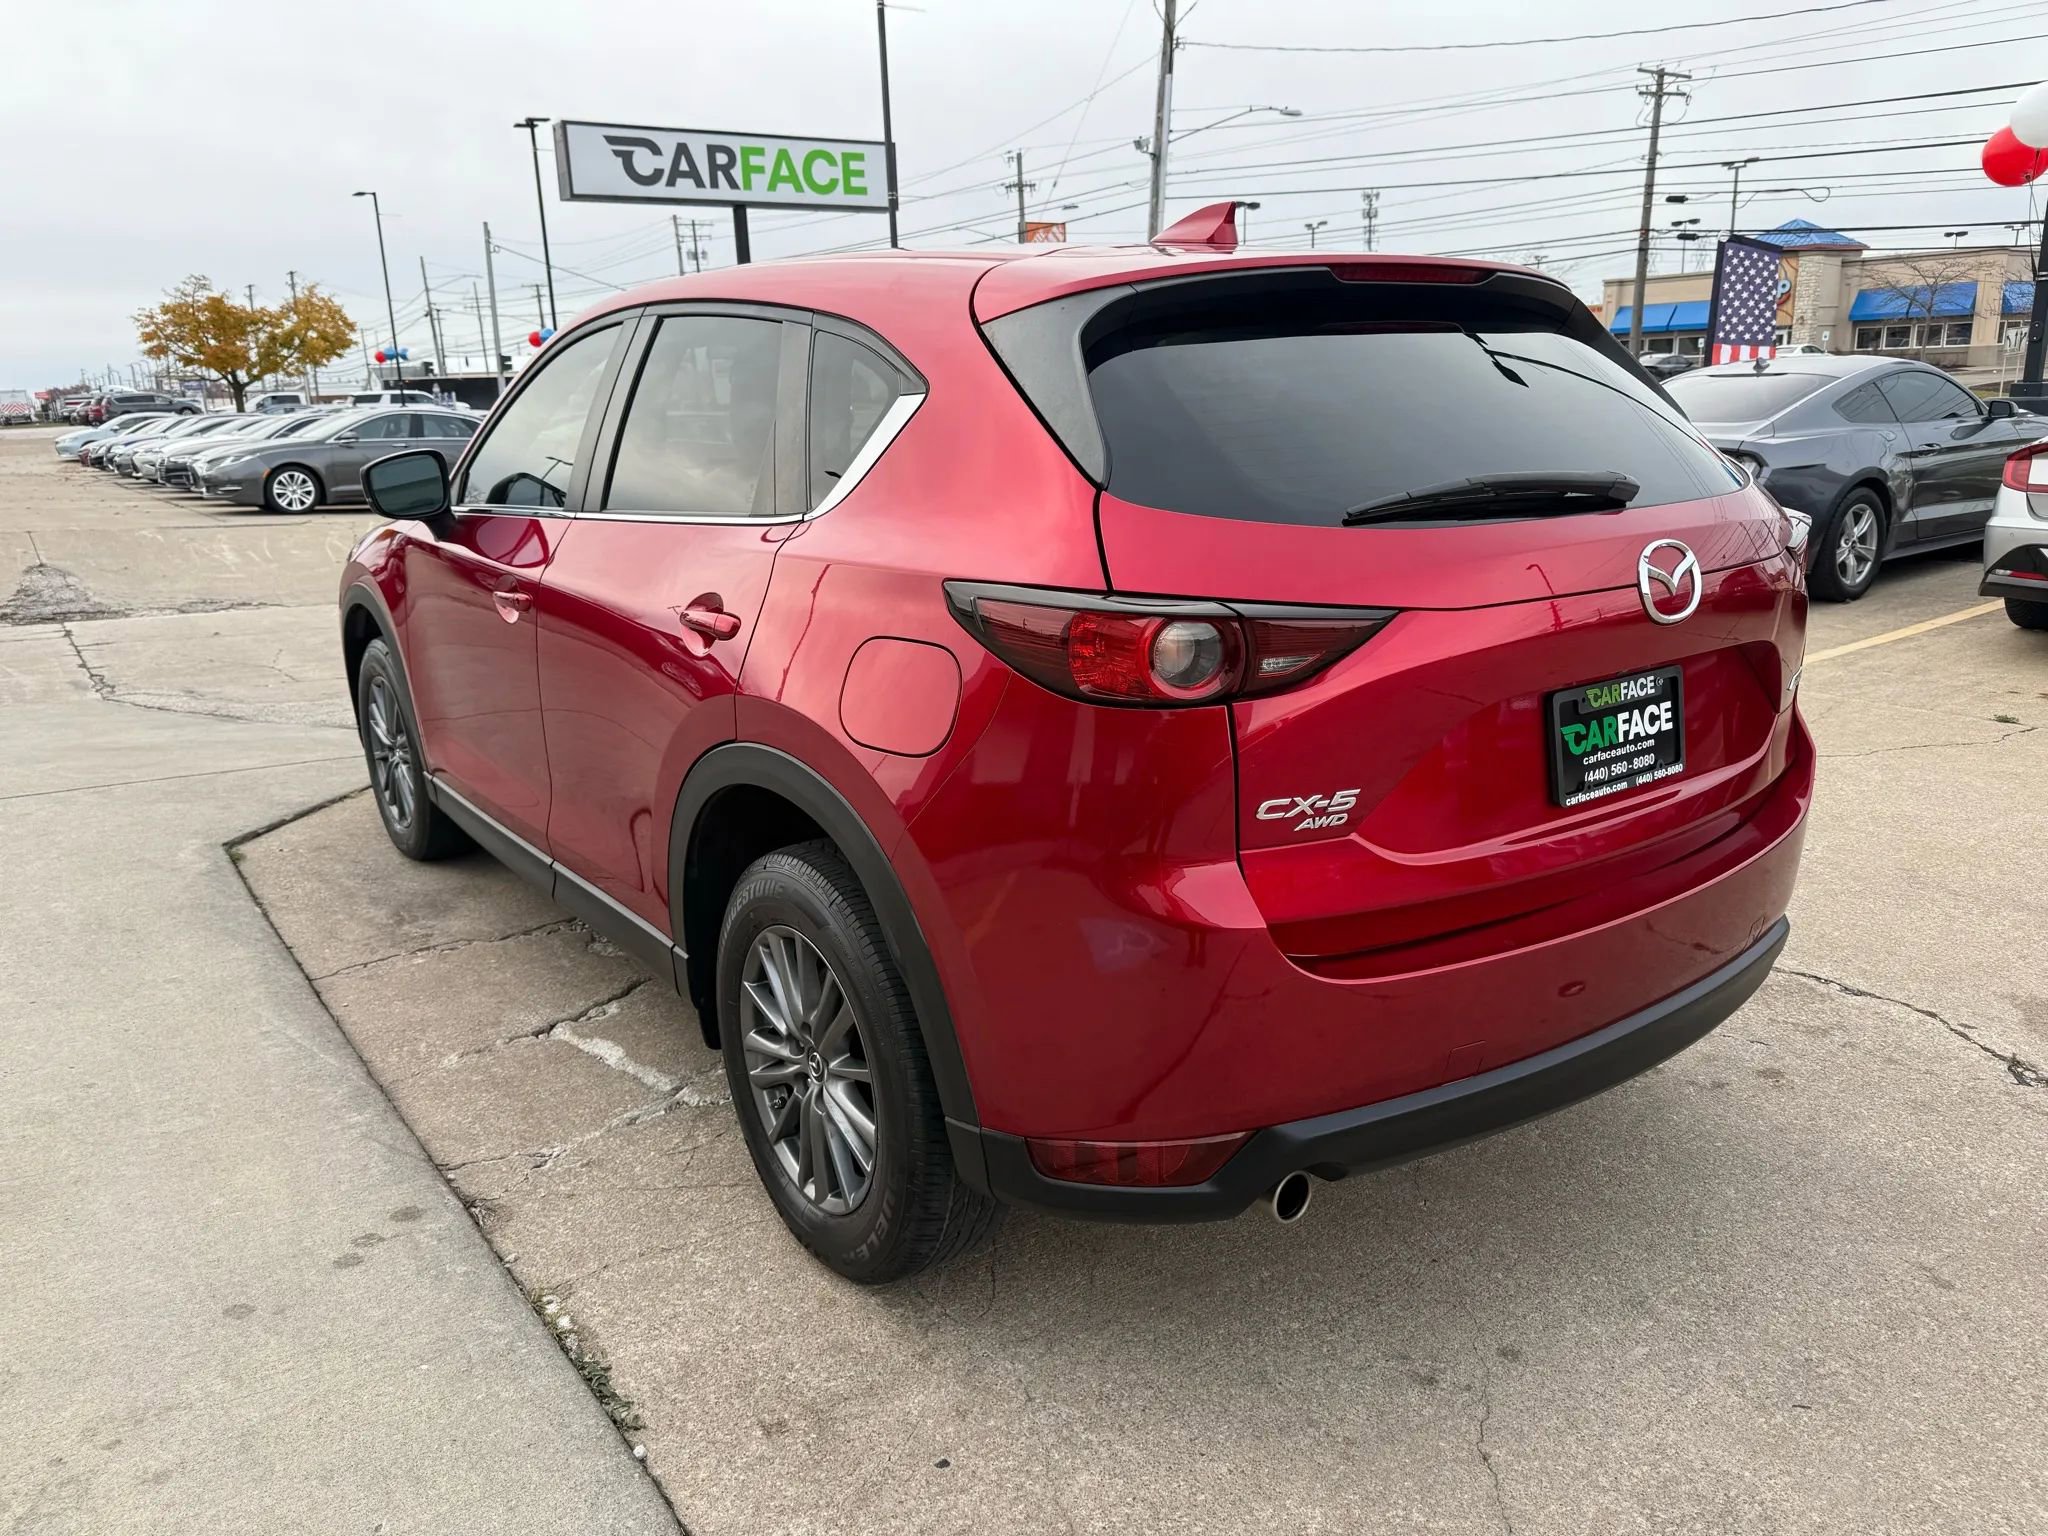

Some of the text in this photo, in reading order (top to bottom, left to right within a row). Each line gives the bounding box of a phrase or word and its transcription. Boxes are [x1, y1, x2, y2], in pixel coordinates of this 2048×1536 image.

[602, 135, 868, 196] CARFACE
[1586, 675, 1656, 708] CARFACE
[1560, 701, 1674, 756] CARFACE
[1583, 738, 1655, 765] carfaceauto.com
[1565, 763, 1684, 807] carfaceauto.com (440) 560-8080
[1584, 766, 1609, 783] (440)
[1256, 788, 1361, 820] CX-5
[1294, 813, 1348, 832] AWD
